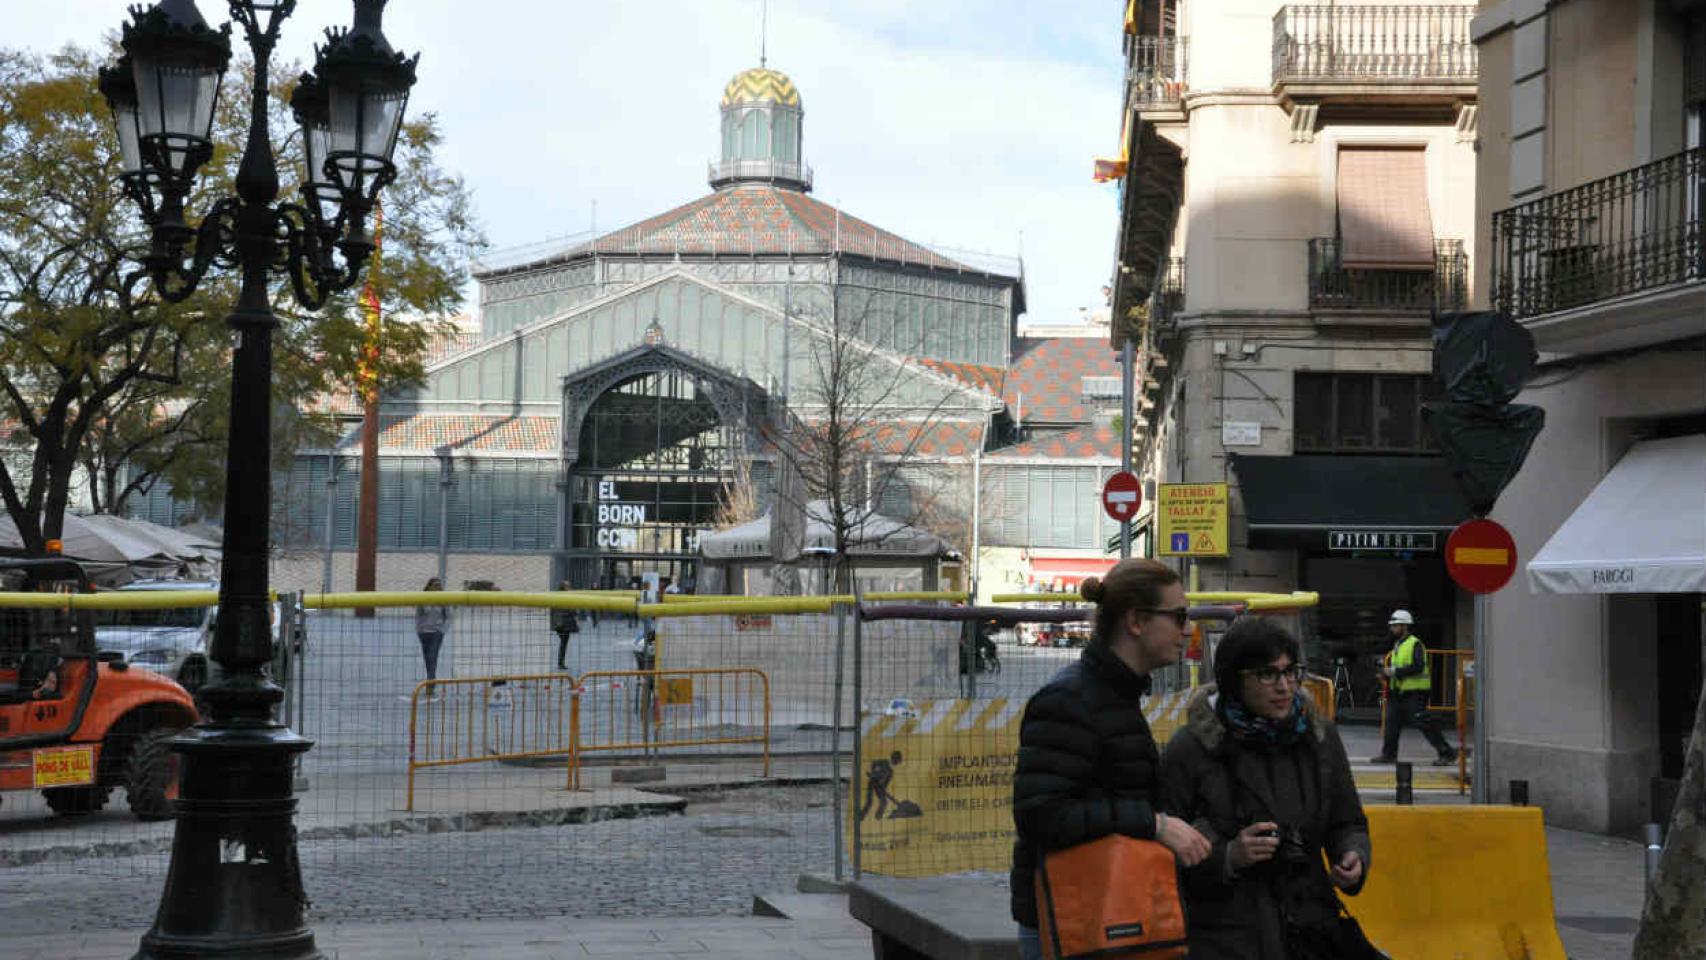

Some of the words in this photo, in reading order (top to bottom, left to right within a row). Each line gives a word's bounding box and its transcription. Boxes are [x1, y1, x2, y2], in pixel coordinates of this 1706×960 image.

[598, 481, 619, 500] EL
[597, 504, 646, 525] BORN
[1168, 505, 1204, 516] TALLAT
[1336, 532, 1379, 547] PITIN
